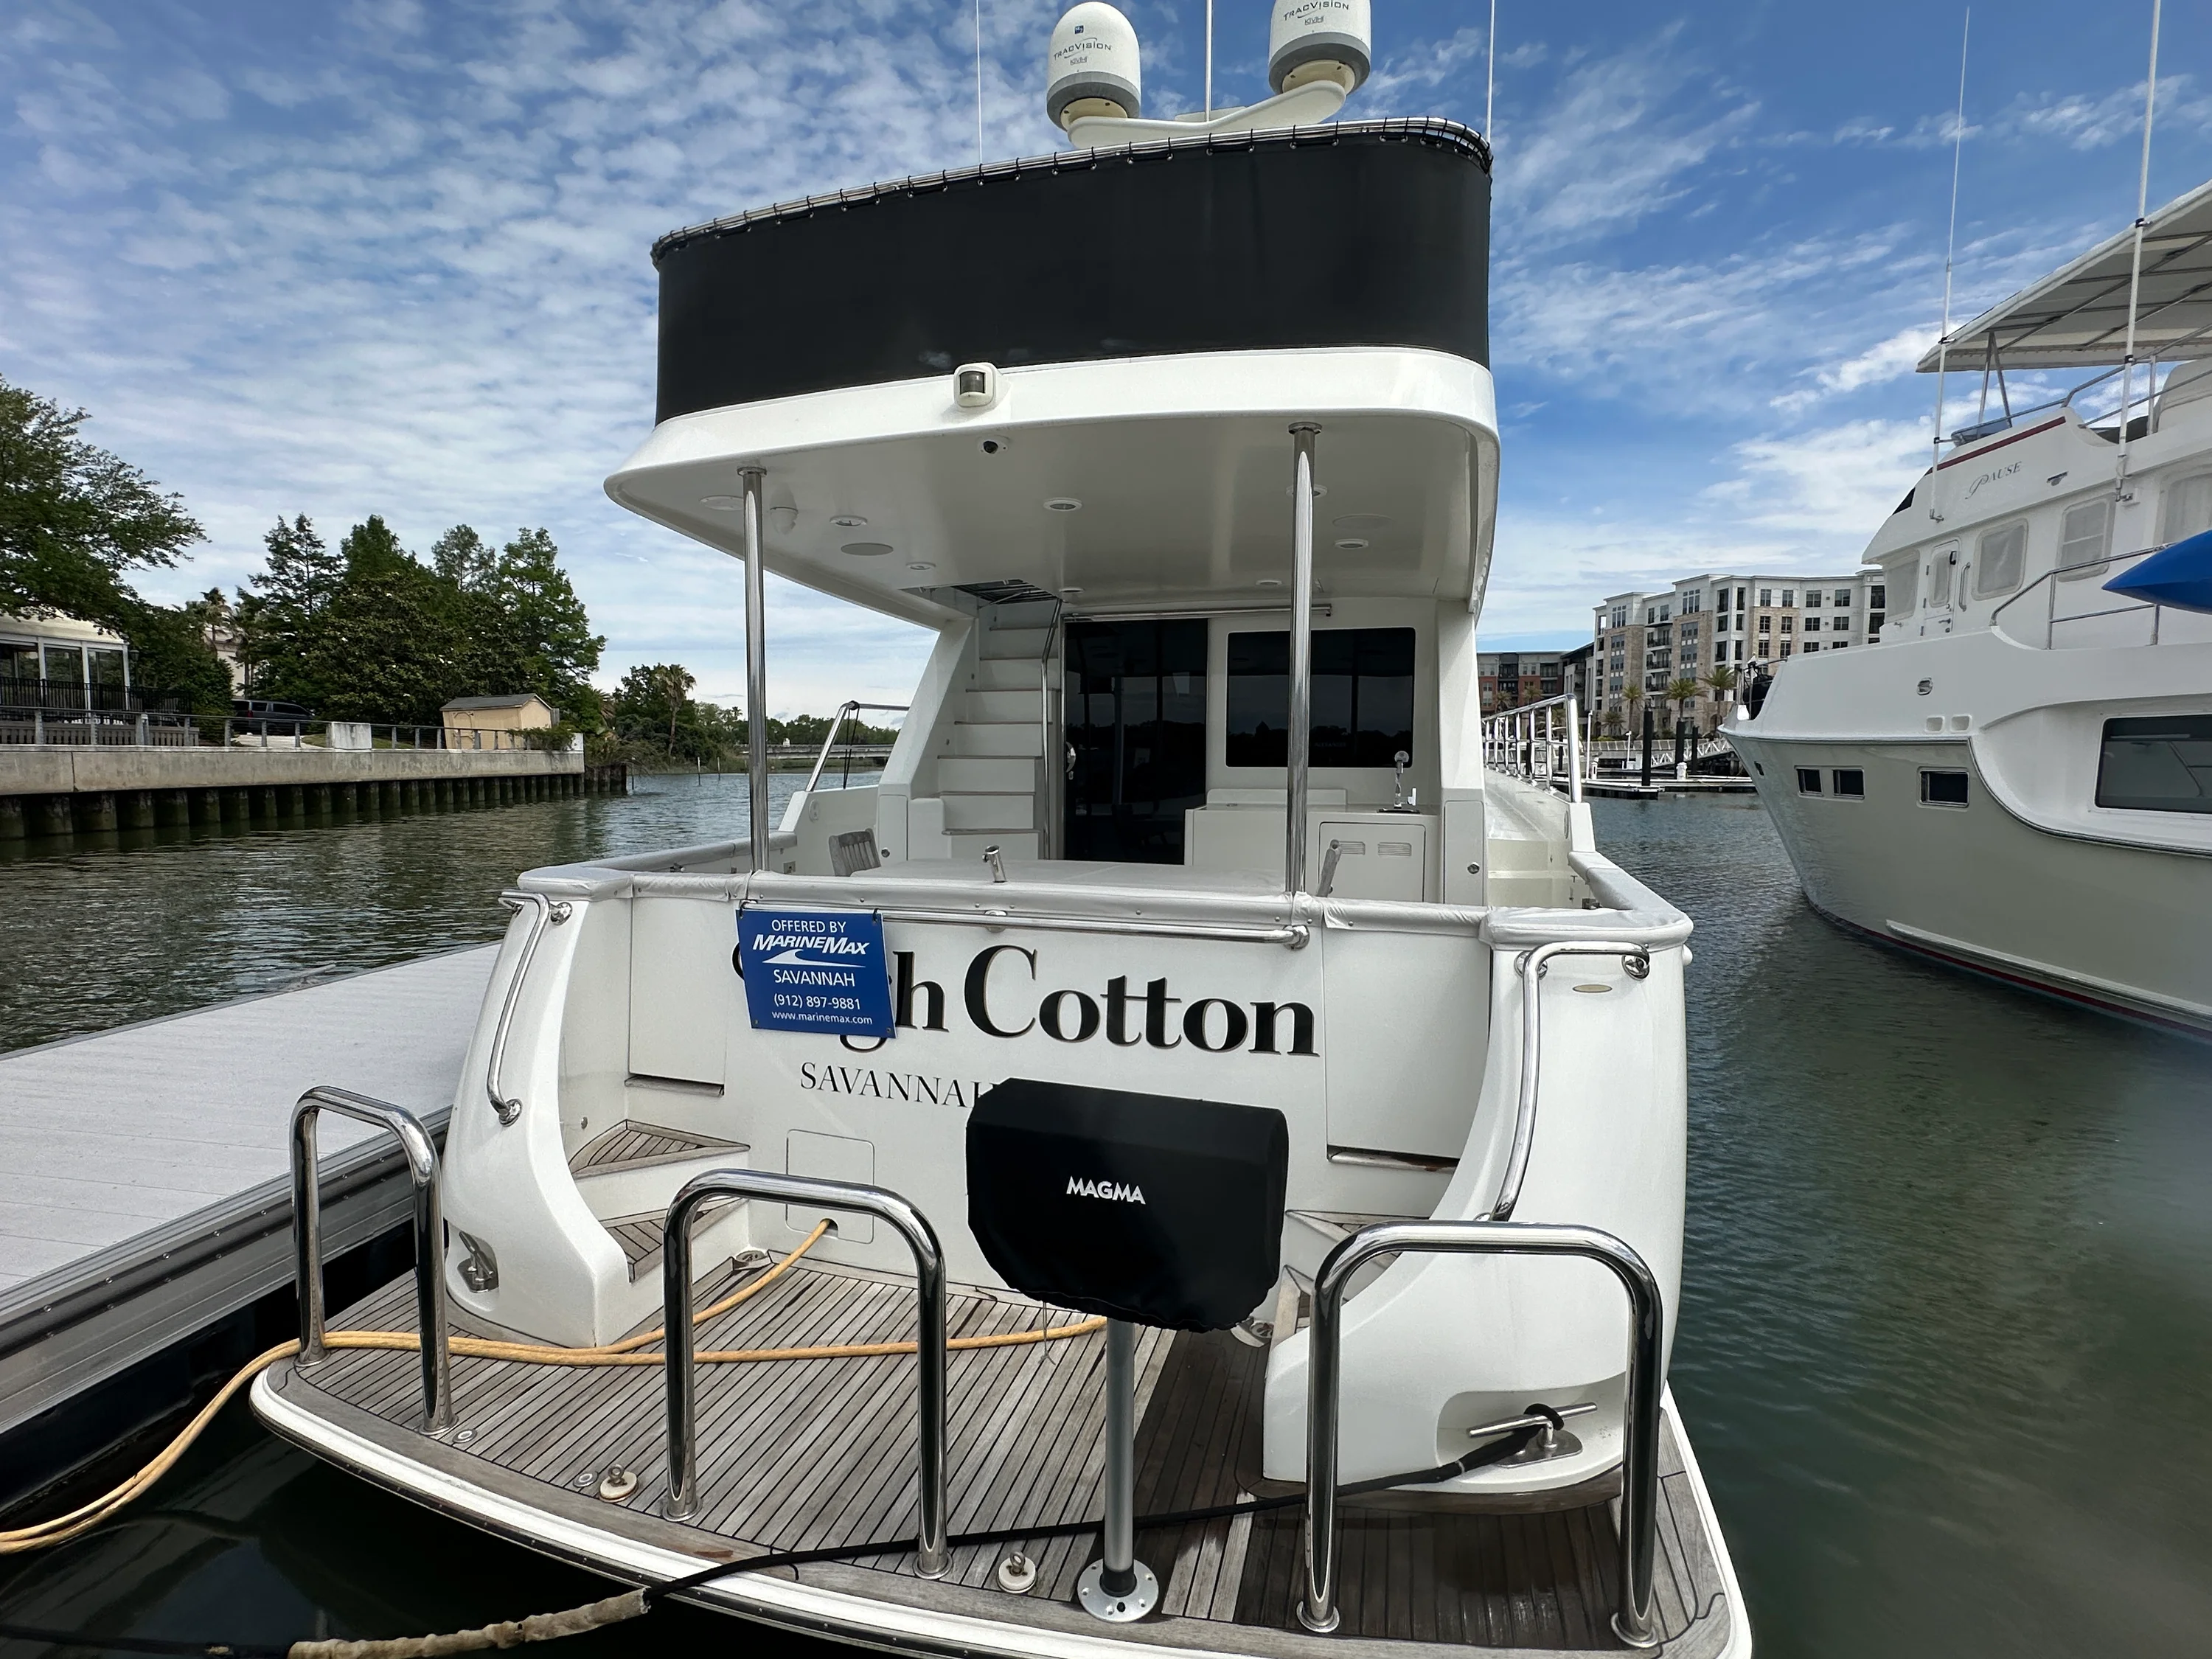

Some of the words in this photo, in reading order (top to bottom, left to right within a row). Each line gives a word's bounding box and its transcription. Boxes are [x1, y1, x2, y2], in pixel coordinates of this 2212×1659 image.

[1283, 0, 1350, 21] TRACVISION
[1053, 41, 1112, 60] TRACVISION
[1964, 461, 2023, 500] PAUSE
[771, 919, 826, 933] OFFERED
[830, 921, 846, 933] BY
[752, 934, 869, 955] MARINEMAX
[773, 969, 855, 987] SAVANNAH
[773, 993, 803, 1009] (912)
[806, 995, 861, 1010] 897-9881
[964, 945, 1321, 1057] Cotton
[771, 1011, 873, 1025] www.marinemax.com
[1066, 1175, 1147, 1205] MAGMA
